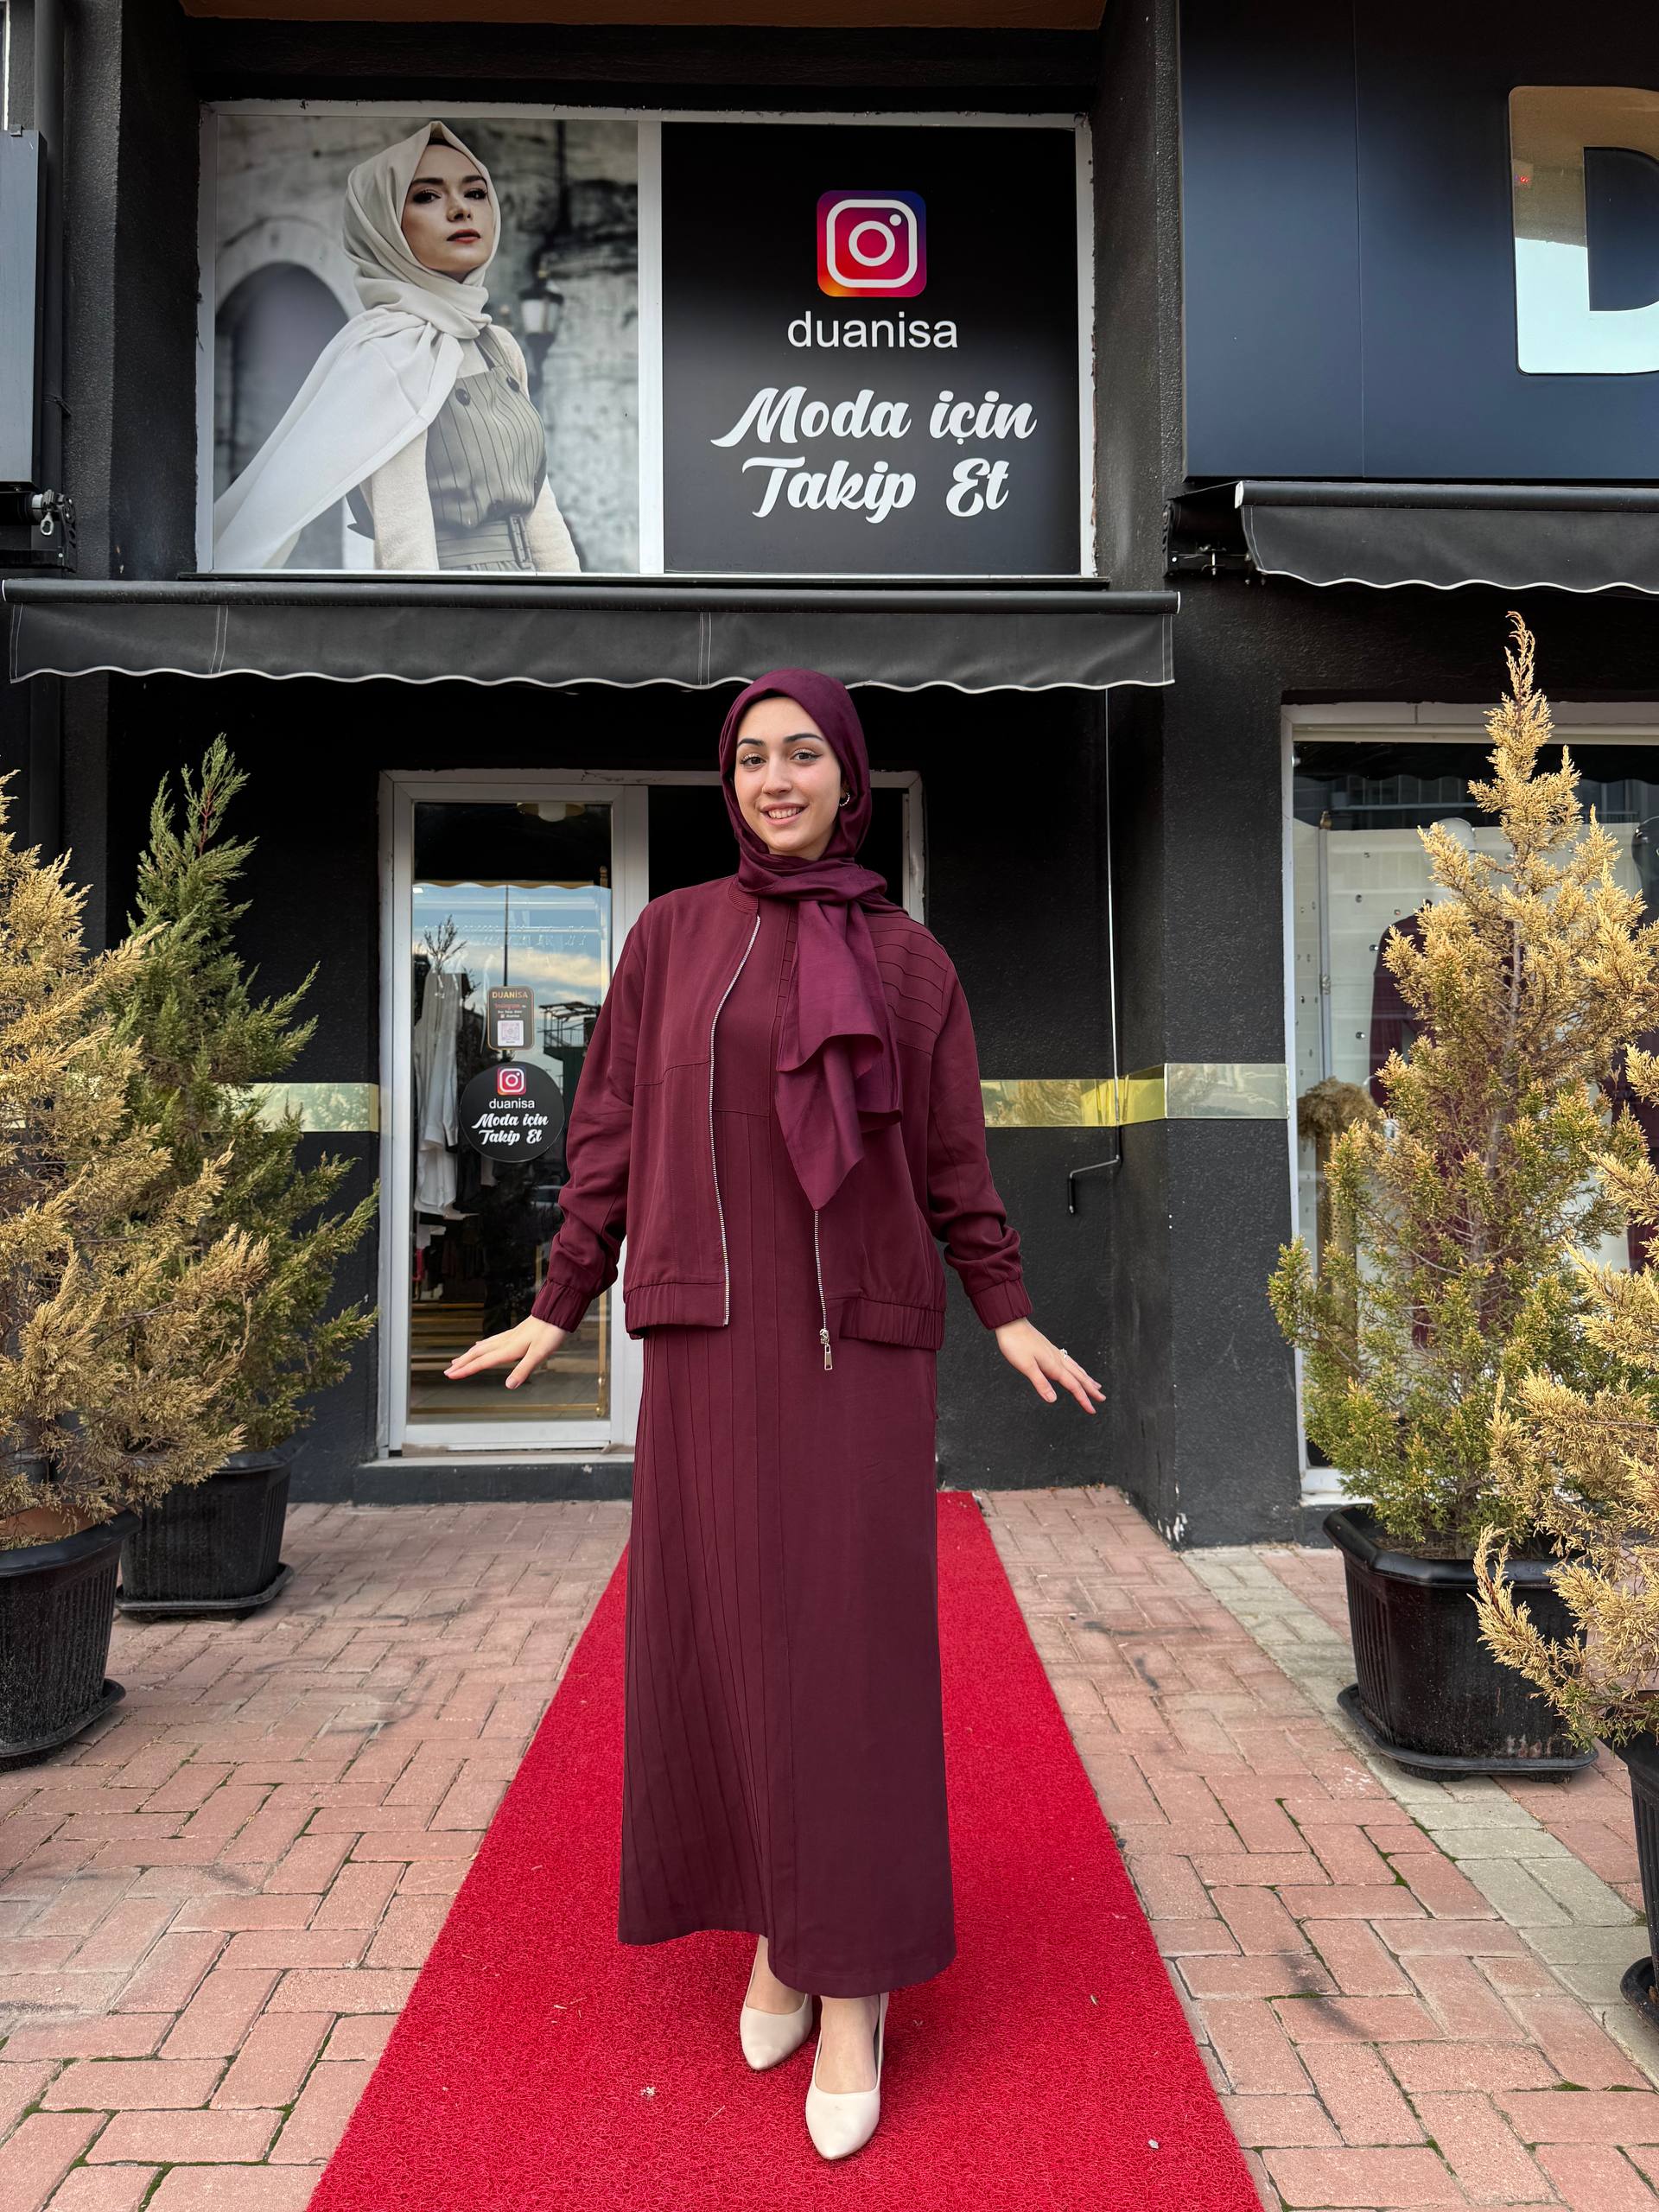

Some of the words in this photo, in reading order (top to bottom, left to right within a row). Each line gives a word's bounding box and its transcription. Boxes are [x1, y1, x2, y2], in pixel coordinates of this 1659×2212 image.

[787, 310, 958, 348] duanisa
[710, 385, 912, 448] Moda
[929, 390, 1037, 445] için
[741, 455, 917, 524] Takip
[945, 457, 1010, 518] Et
[489, 1097, 535, 1109] duanisa
[471, 1113, 519, 1129] Moda
[522, 1113, 549, 1127] için
[478, 1129, 520, 1146] Takip
